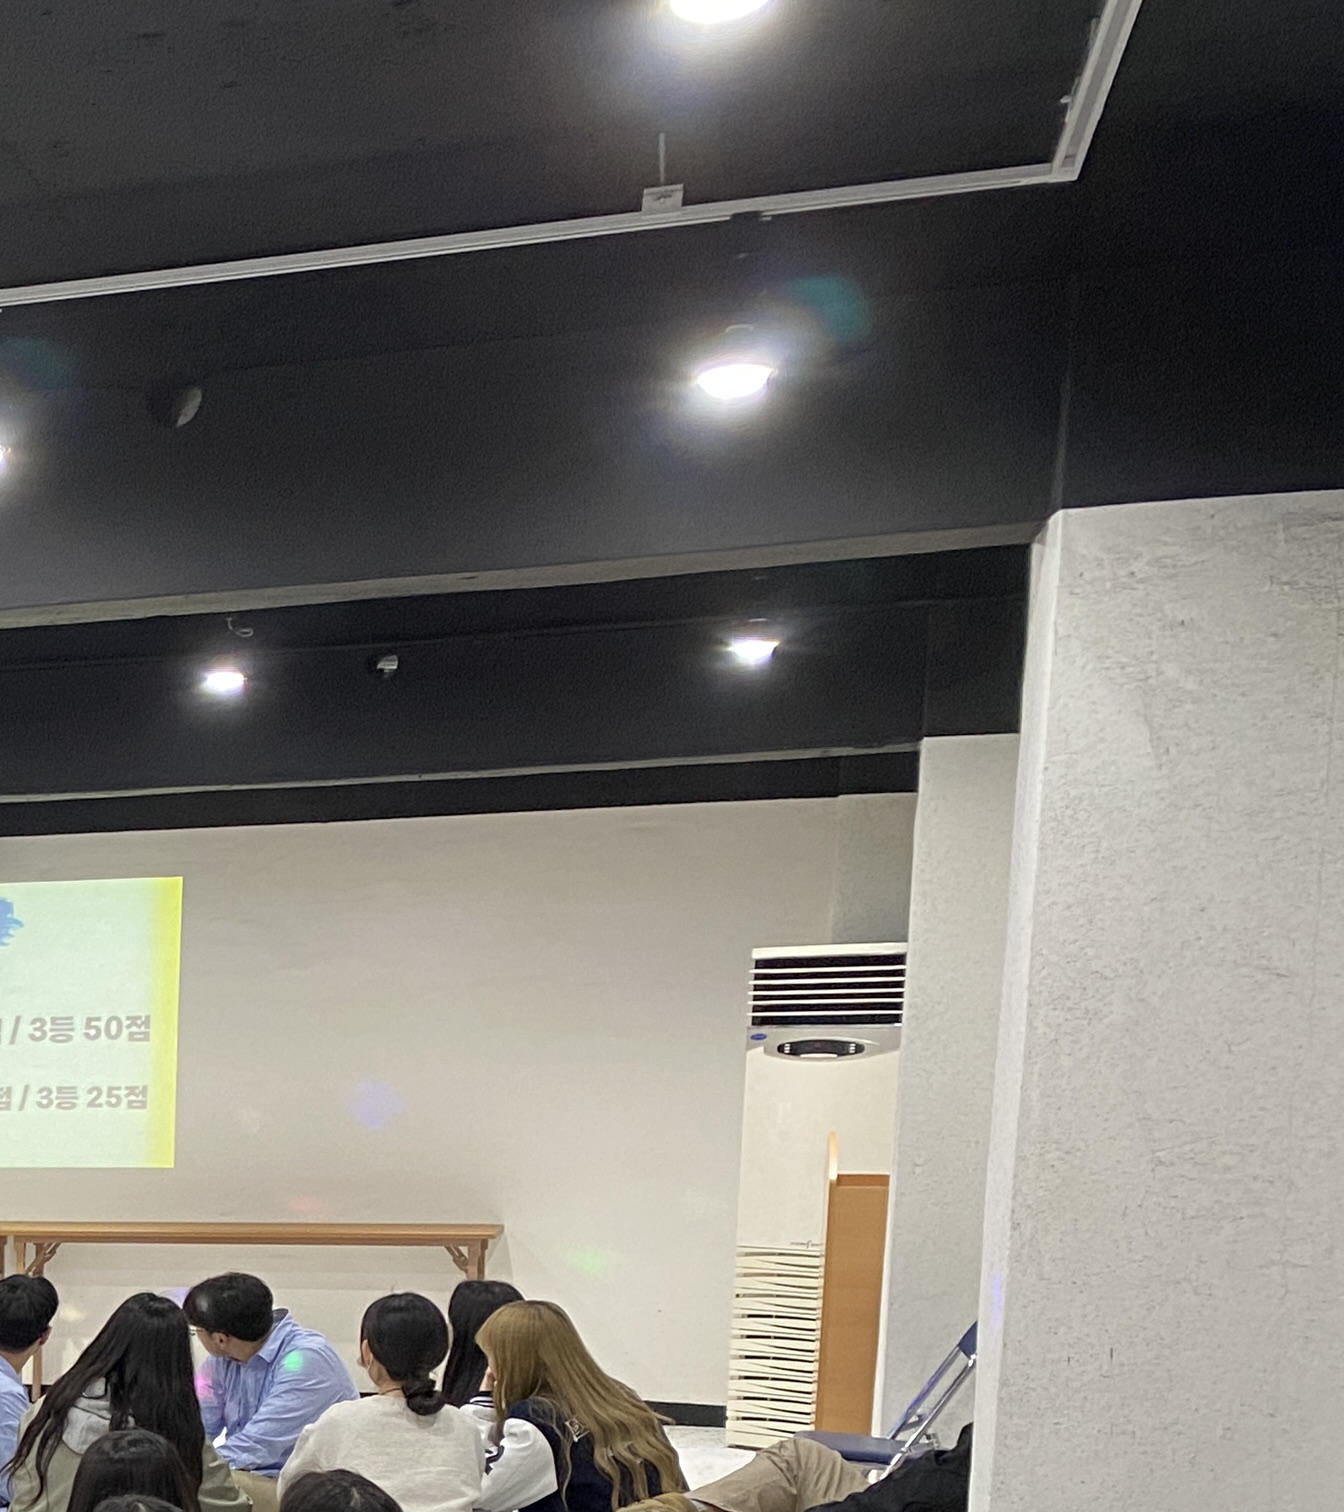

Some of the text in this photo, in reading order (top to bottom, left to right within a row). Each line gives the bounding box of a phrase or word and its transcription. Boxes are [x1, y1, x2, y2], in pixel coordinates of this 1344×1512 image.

[8, 1015, 21, 1045] /
[28, 1015, 75, 1043] 3등
[83, 1014, 151, 1042] 50점
[17, 1084, 30, 1111] /
[35, 1085, 79, 1110] 3등
[86, 1084, 148, 1110] 25점
